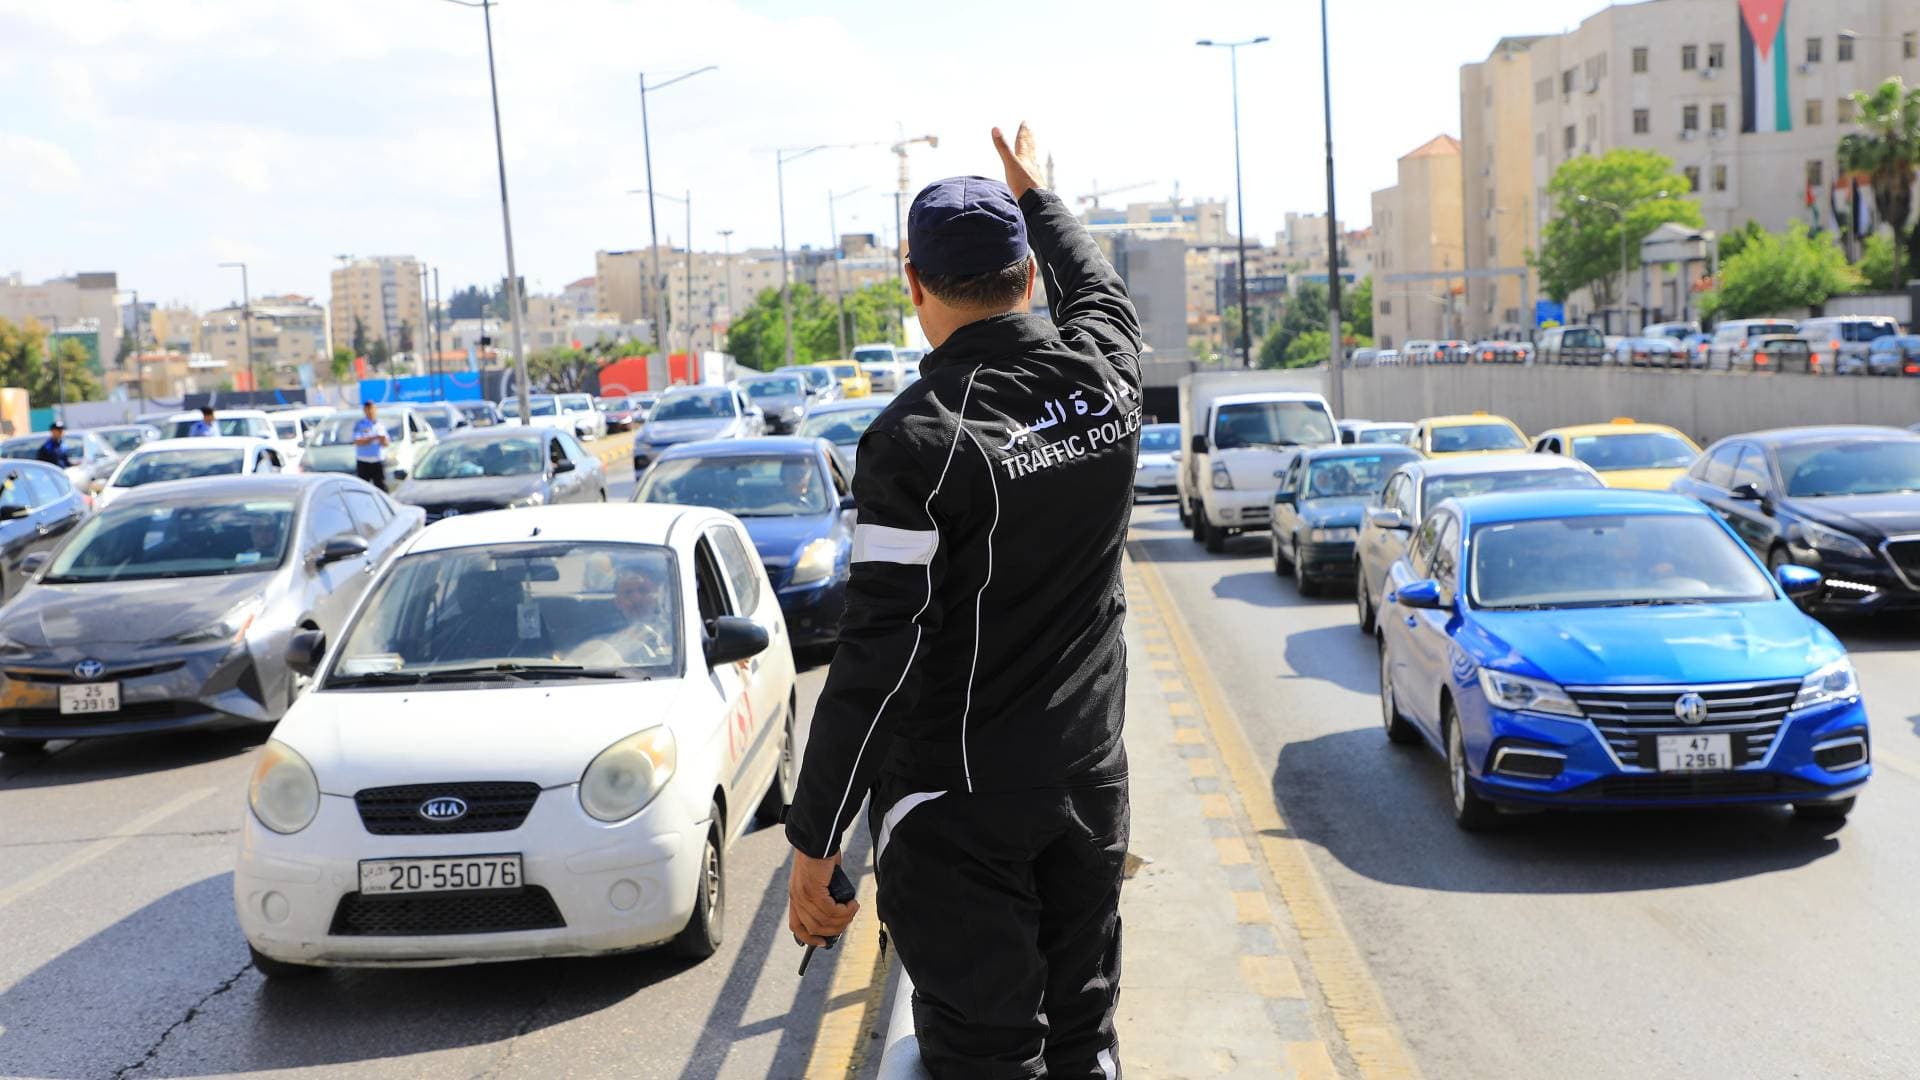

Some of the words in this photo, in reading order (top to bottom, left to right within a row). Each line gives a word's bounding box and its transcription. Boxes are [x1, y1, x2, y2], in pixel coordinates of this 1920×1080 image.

[998, 399, 1066, 450] السير
[1001, 435, 1085, 480] TRAFFIC
[85, 685, 102, 697] 25
[1690, 738, 1709, 751] 47
[1676, 753, 1726, 768] 12961
[428, 802, 459, 816] KIA
